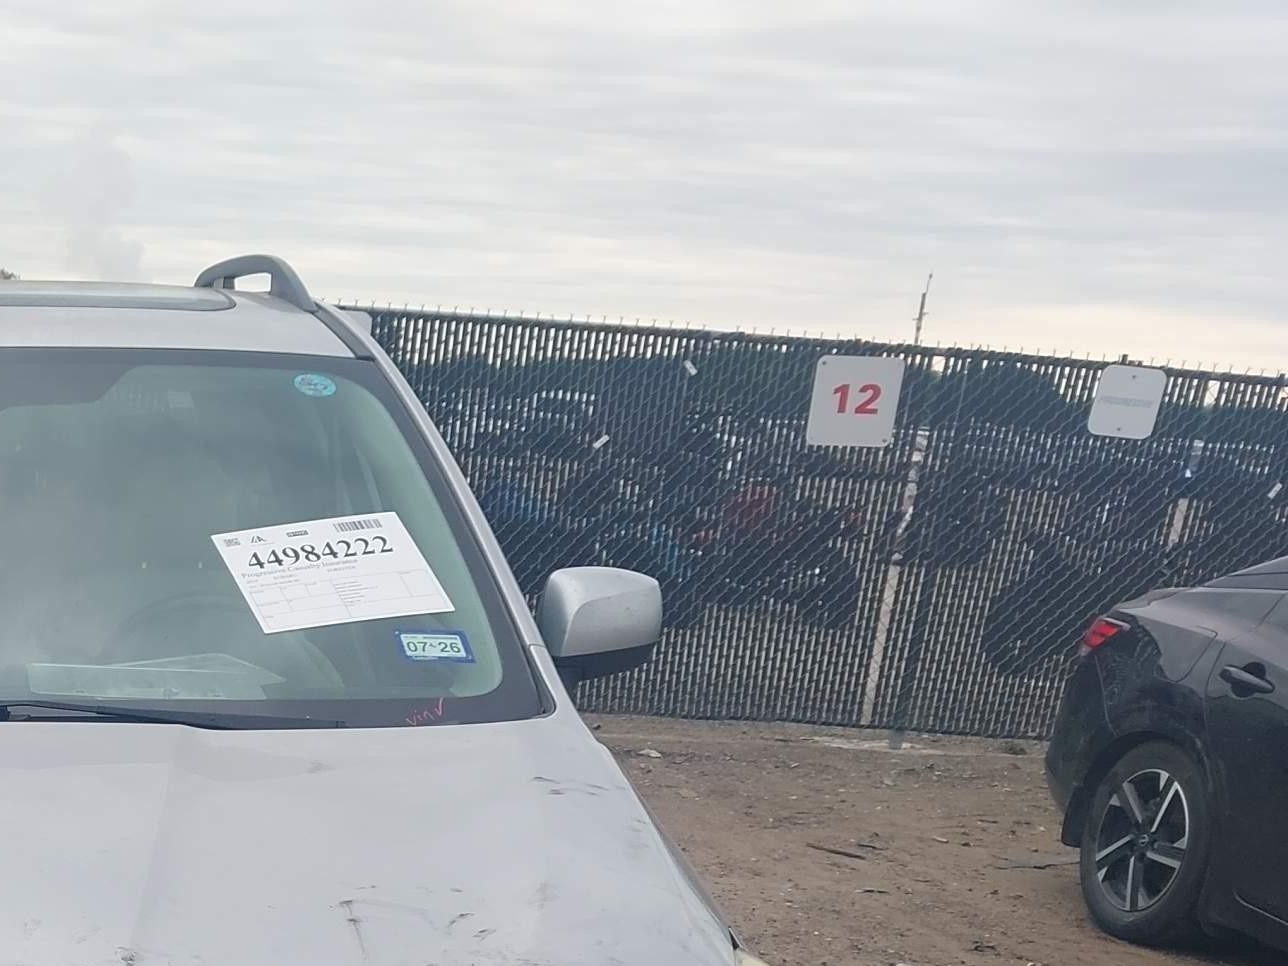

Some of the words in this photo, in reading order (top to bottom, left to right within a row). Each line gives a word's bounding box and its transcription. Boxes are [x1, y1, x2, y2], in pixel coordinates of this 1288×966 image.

[833, 384, 881, 415] 12
[248, 536, 394, 569] 44984222
[406, 641, 428, 652] 07
[438, 641, 461, 653] 26
